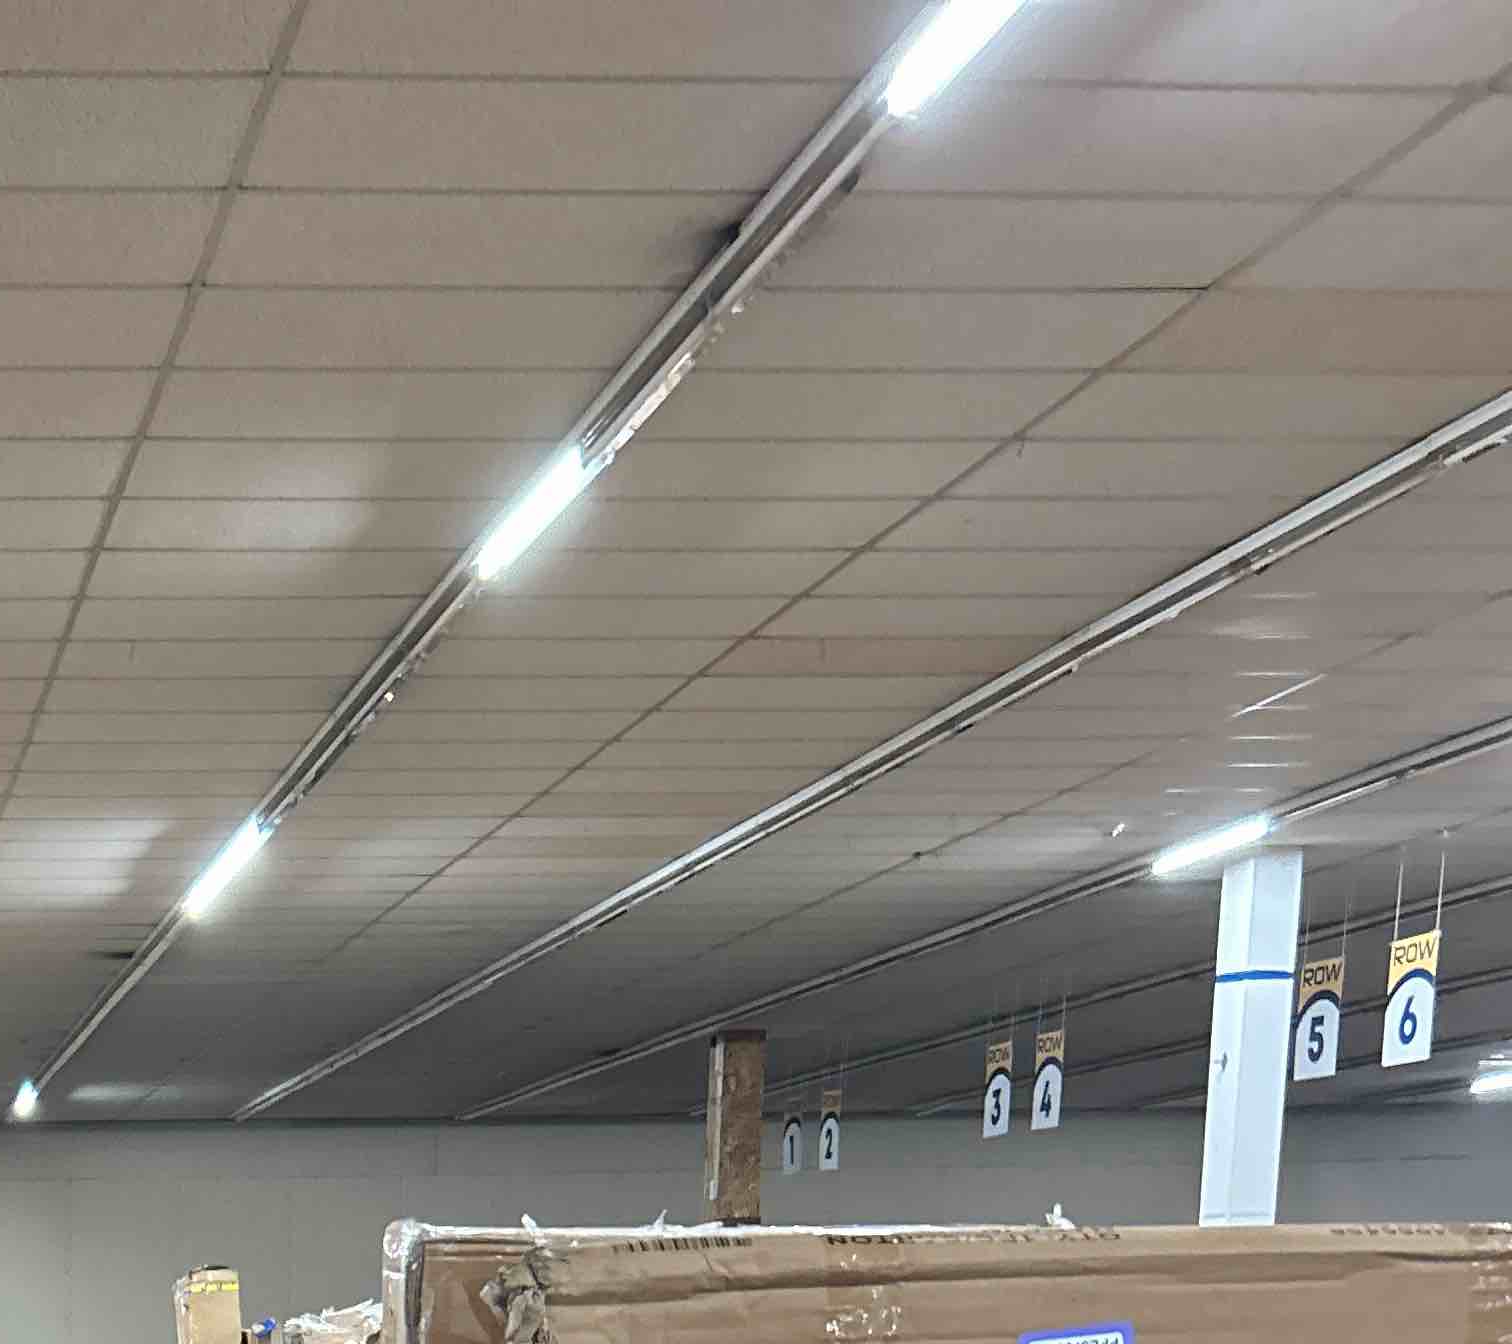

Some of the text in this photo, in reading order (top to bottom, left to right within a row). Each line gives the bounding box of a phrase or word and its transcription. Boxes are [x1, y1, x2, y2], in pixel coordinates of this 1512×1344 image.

[1393, 937, 1438, 967] ROW
[1303, 961, 1342, 987] ROW
[1398, 995, 1418, 1045] 6
[1037, 1036, 1063, 1054] ROW
[1307, 1016, 1325, 1062] 5
[988, 1048, 1010, 1066] ROW
[990, 1088, 1002, 1126] 3
[1040, 1080, 1052, 1118] 4
[788, 1135, 795, 1164] 1
[824, 1128, 833, 1160] 2
